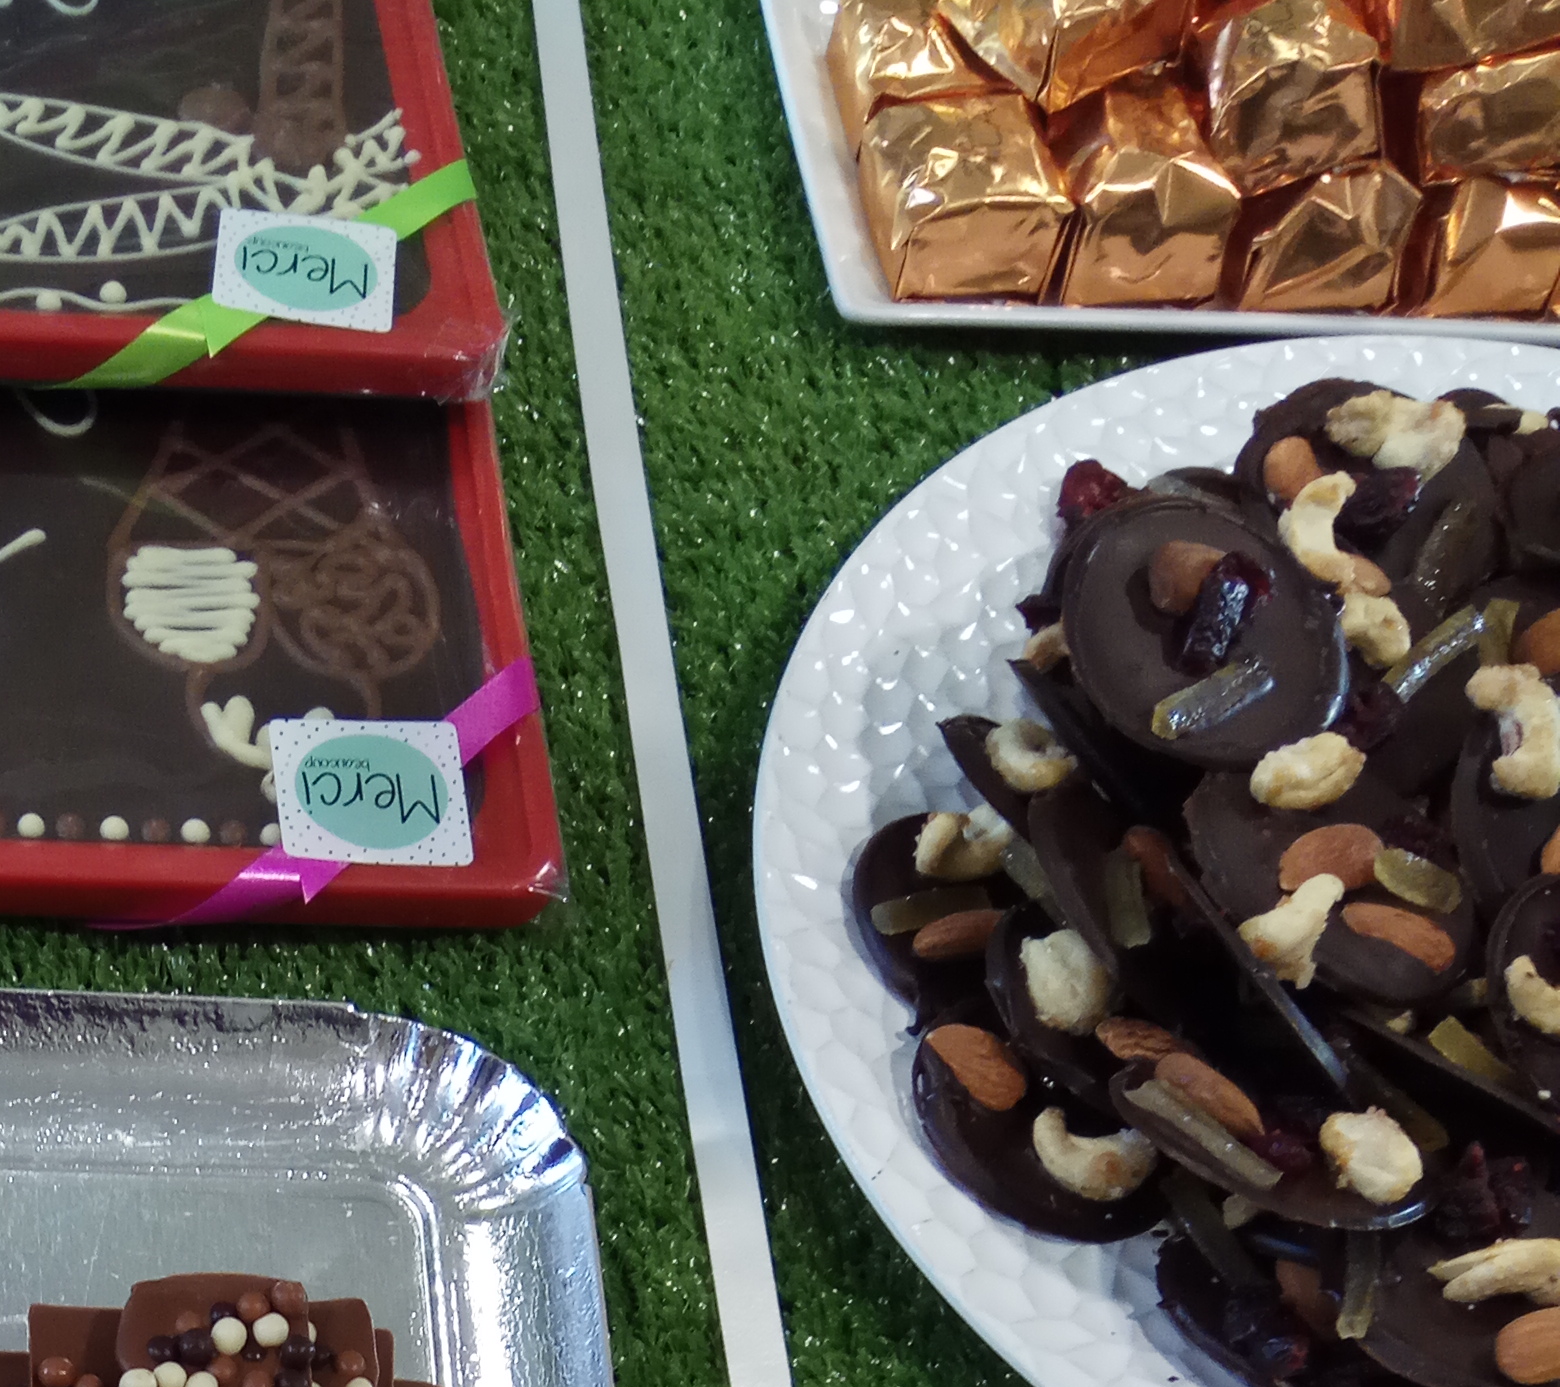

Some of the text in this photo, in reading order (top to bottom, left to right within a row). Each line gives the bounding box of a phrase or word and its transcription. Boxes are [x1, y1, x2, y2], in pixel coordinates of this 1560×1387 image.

[241, 244, 367, 299] Merci
[304, 755, 369, 771] beaucoup
[300, 770, 439, 823] Merci
